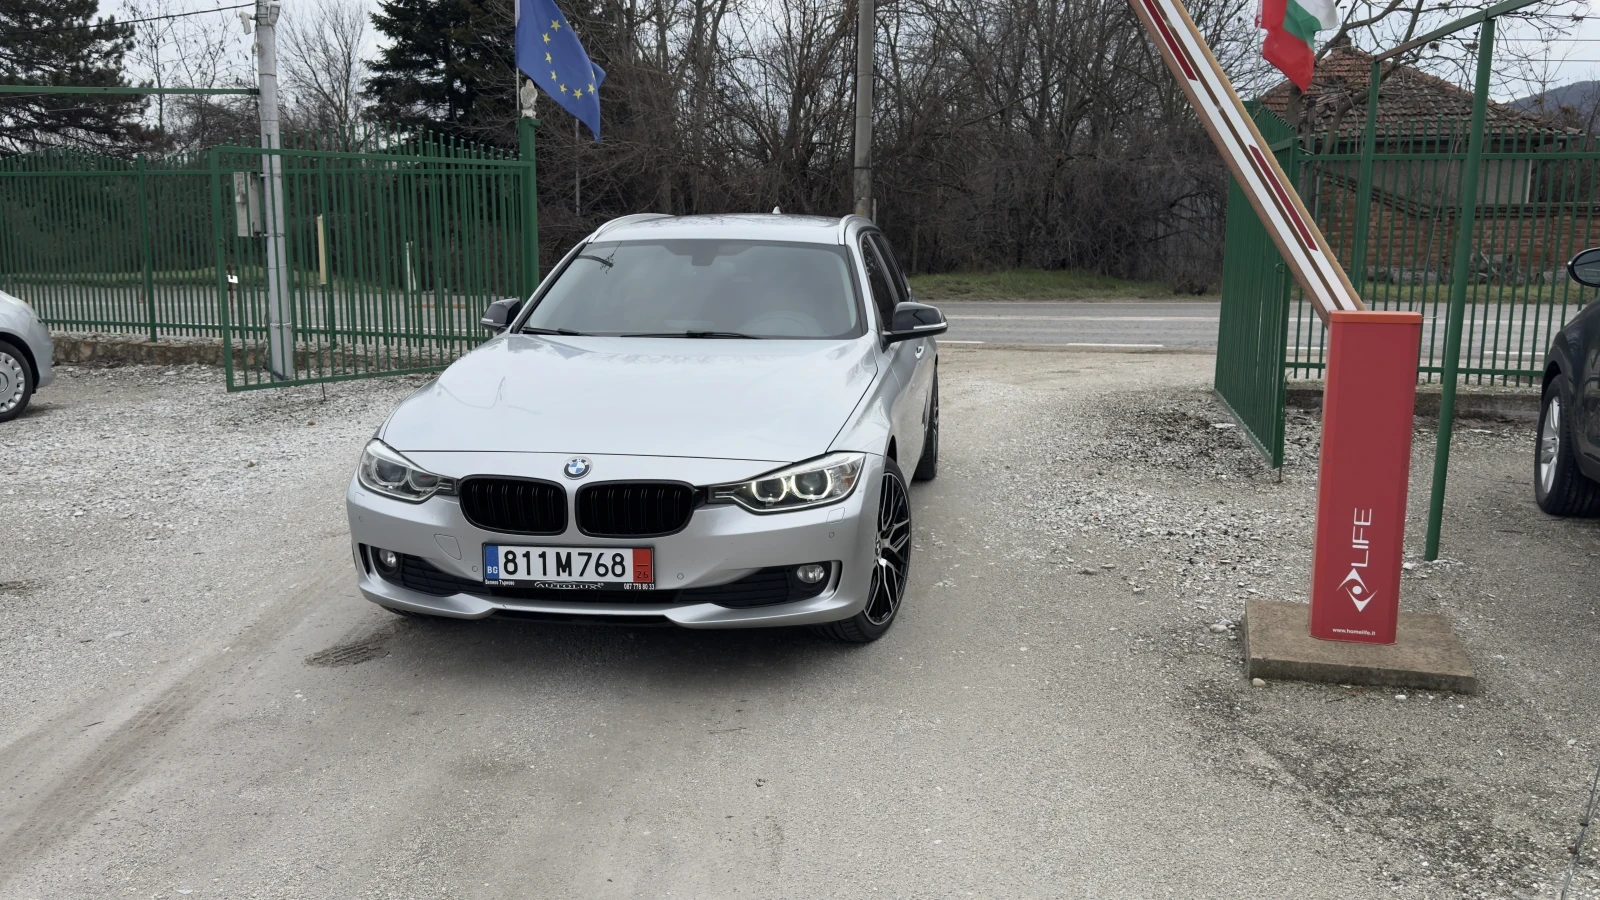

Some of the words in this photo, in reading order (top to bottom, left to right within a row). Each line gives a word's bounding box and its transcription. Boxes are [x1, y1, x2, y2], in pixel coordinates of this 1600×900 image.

[1350, 507, 1372, 568] LIFE
[503, 549, 626, 578] 811M768
[487, 566, 499, 574] BG
[637, 570, 649, 579] 26
[1332, 628, 1376, 636] www.homelife.it
